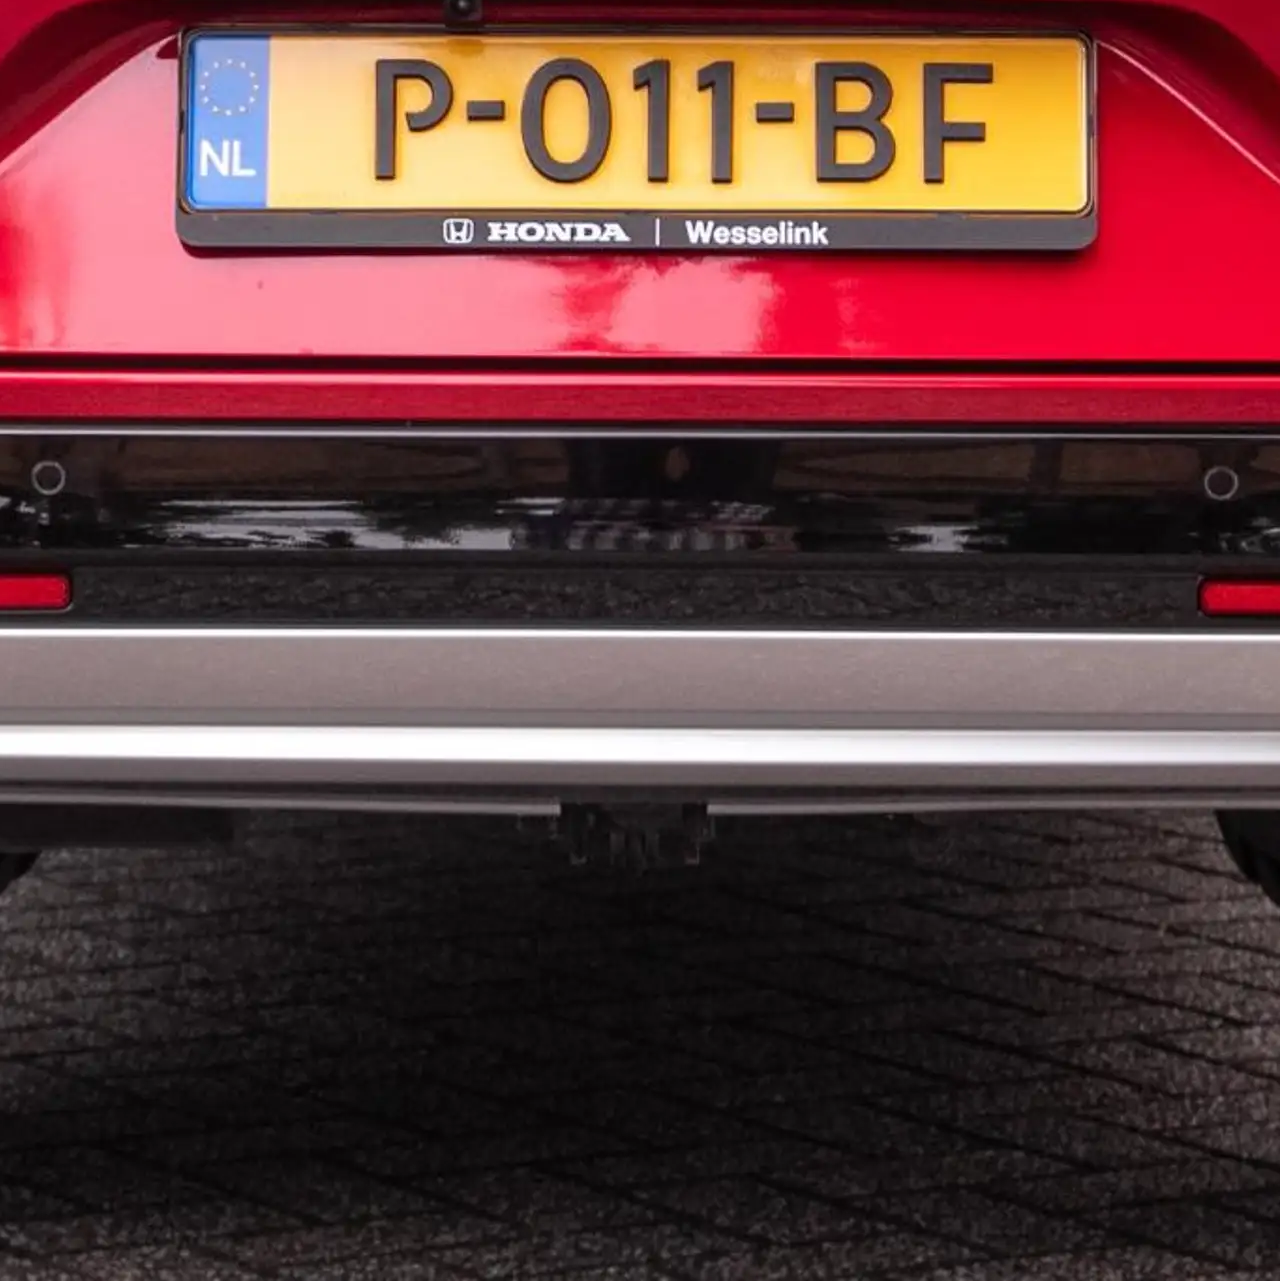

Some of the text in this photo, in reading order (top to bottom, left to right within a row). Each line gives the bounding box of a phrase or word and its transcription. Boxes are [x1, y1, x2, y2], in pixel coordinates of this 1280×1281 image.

[199, 57, 994, 184] NL P-011-BF
[487, 222, 631, 242] HONDA
[684, 221, 828, 246] Wesselink
